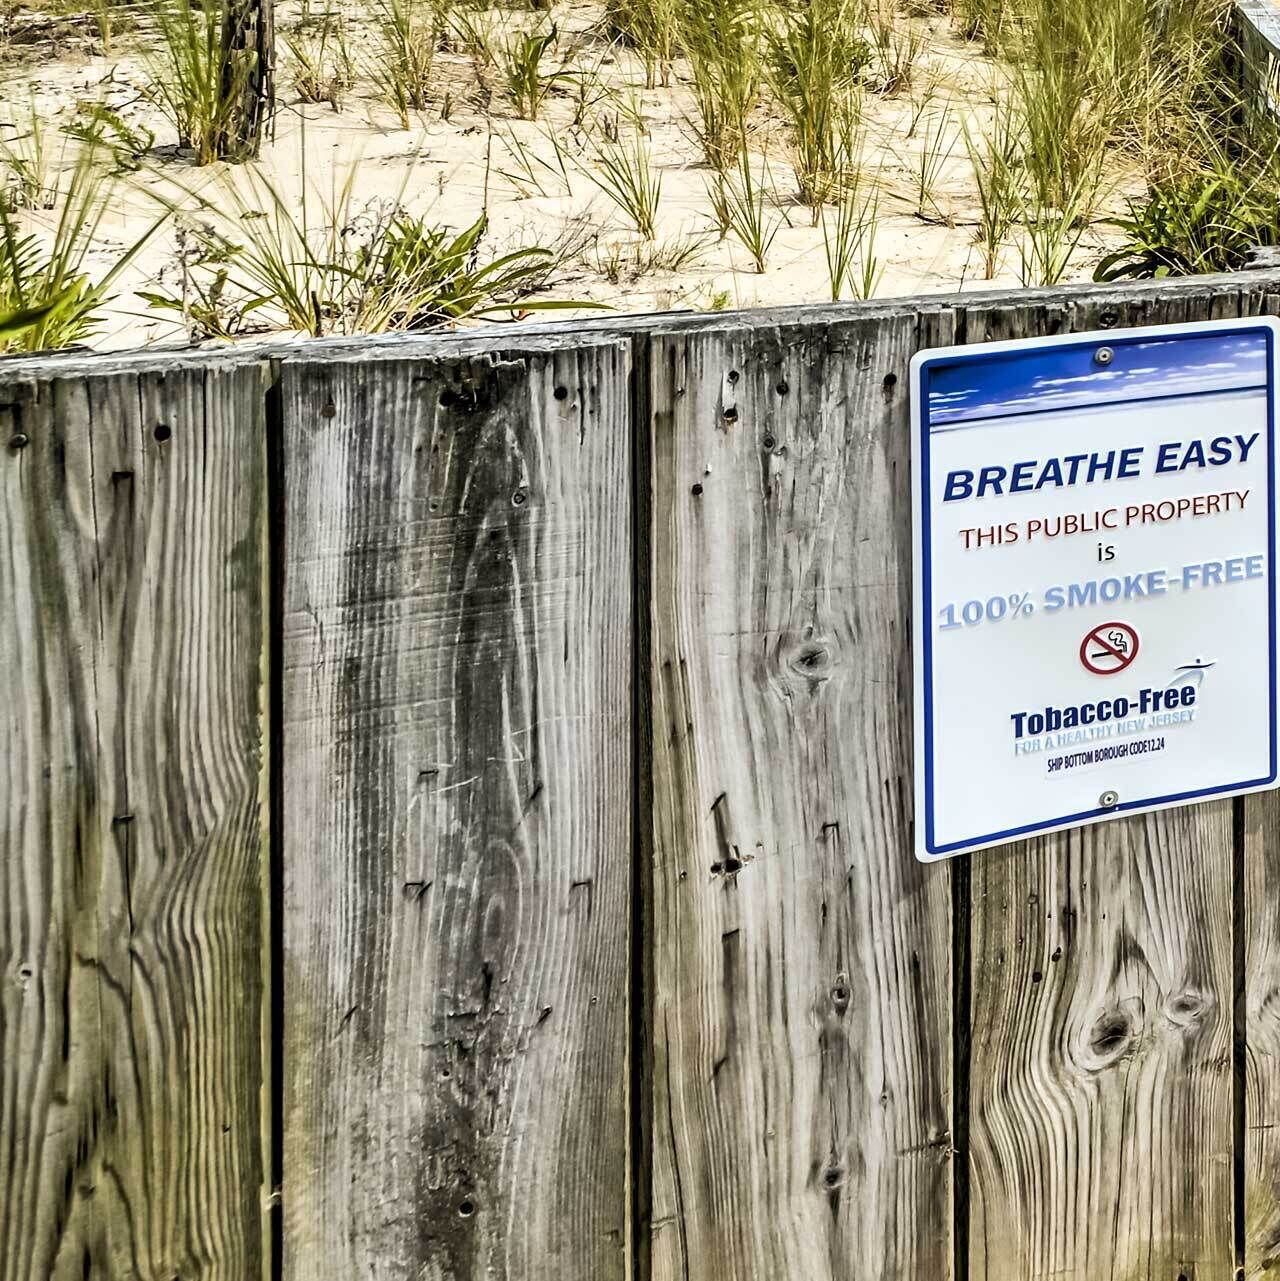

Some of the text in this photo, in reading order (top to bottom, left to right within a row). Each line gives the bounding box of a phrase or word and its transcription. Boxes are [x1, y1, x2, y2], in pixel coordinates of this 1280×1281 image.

[943, 433, 1260, 502] BREATHE EASY
[960, 490, 1250, 549] THIS PUBLIC PROPERTY
[1098, 542, 1115, 561] is
[938, 554, 1264, 630] 100% SMOKE-FREE
[1011, 686, 1195, 738] Tobacco-Free
[1015, 709, 1195, 756] FOR A HEALTHY NEW JERSEY
[1048, 757, 1063, 772] SHIP
[1064, 750, 1093, 768] BOTTOM
[1095, 744, 1128, 761] BOROUGH
